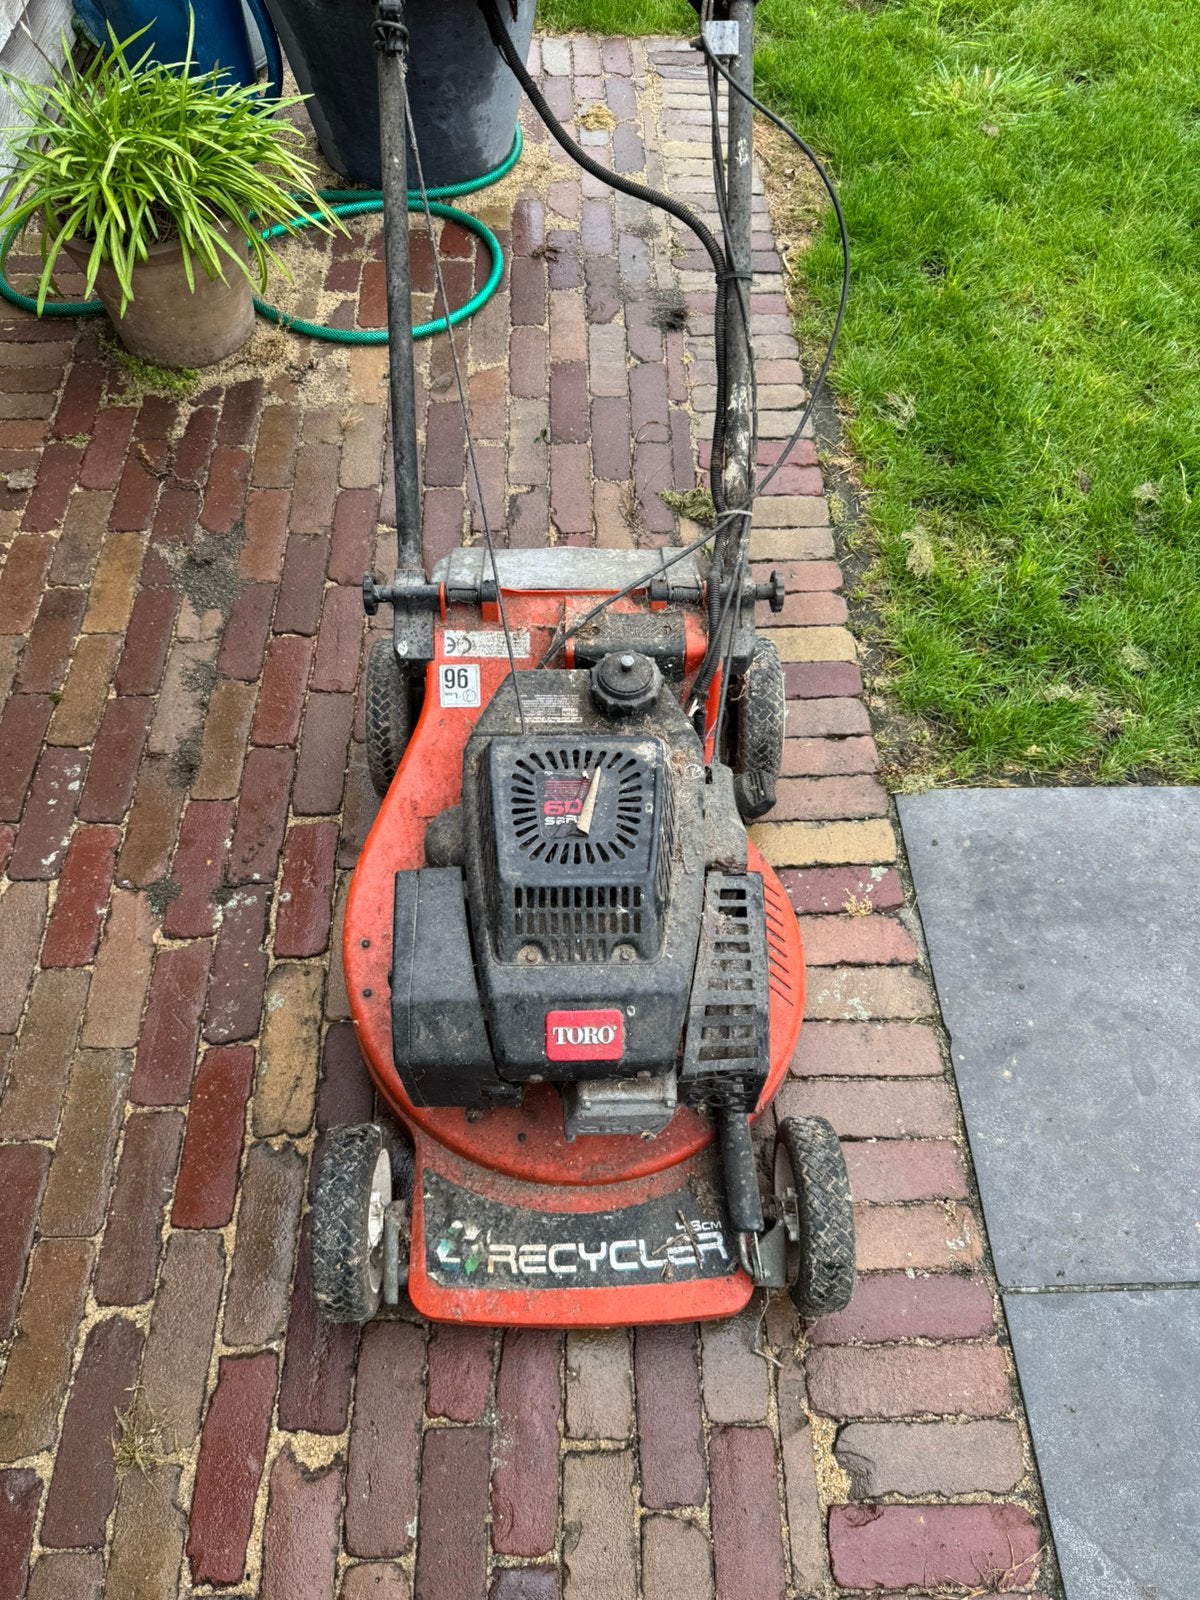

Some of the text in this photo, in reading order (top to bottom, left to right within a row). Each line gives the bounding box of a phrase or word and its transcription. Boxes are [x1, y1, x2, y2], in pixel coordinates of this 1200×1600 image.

[445, 668, 468, 689] 96
[543, 798, 583, 816] 60
[552, 1026, 616, 1045] TORO
[486, 1231, 729, 1275] RECYCLER
